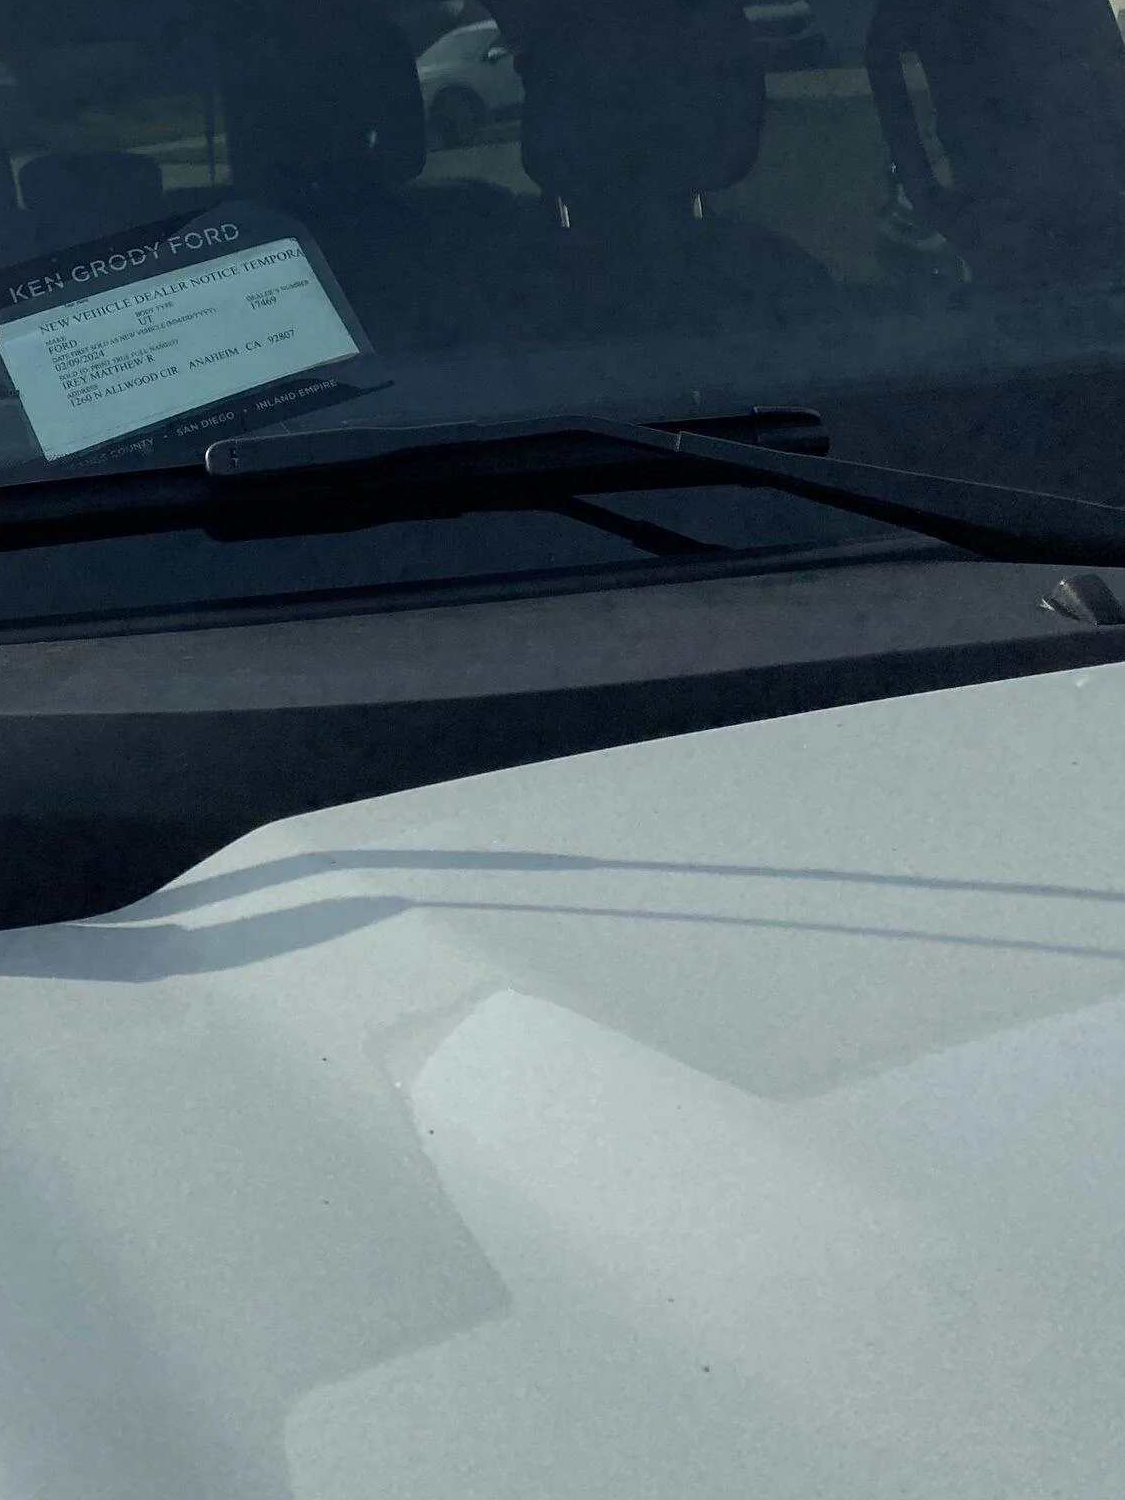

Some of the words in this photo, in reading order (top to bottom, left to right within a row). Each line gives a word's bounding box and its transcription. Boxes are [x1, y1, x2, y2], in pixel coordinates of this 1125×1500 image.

[9, 273, 64, 303] KEN
[71, 241, 160, 282] GRODY
[167, 223, 239, 254] FORD
[38, 318, 70, 335] NEW
[73, 298, 133, 323] VEHICLE
[134, 281, 188, 304] DEALER
[190, 265, 240, 287] NOTICE
[250, 296, 277, 310] 17469
[138, 314, 153, 326] UT
[48, 339, 77, 355] FORD
[55, 350, 105, 372] 02/09/2024
[62, 375, 87, 390] IREY
[90, 358, 143, 381] MATTHEW
[145, 354, 155, 363] R
[70, 394, 92, 408] 1260
[93, 390, 103, 400] N
[104, 372, 159, 397] ALLWOOD
[160, 366, 179, 378] CIR
[189, 347, 240, 369] ANAHEIM
[245, 340, 262, 352] CA
[267, 328, 296, 344] 92807
[176, 422, 199, 437] SAN
[201, 412, 235, 428] DIEGO
[256, 391, 297, 411] INLAND
[299, 378, 337, 398] EMPIRE
